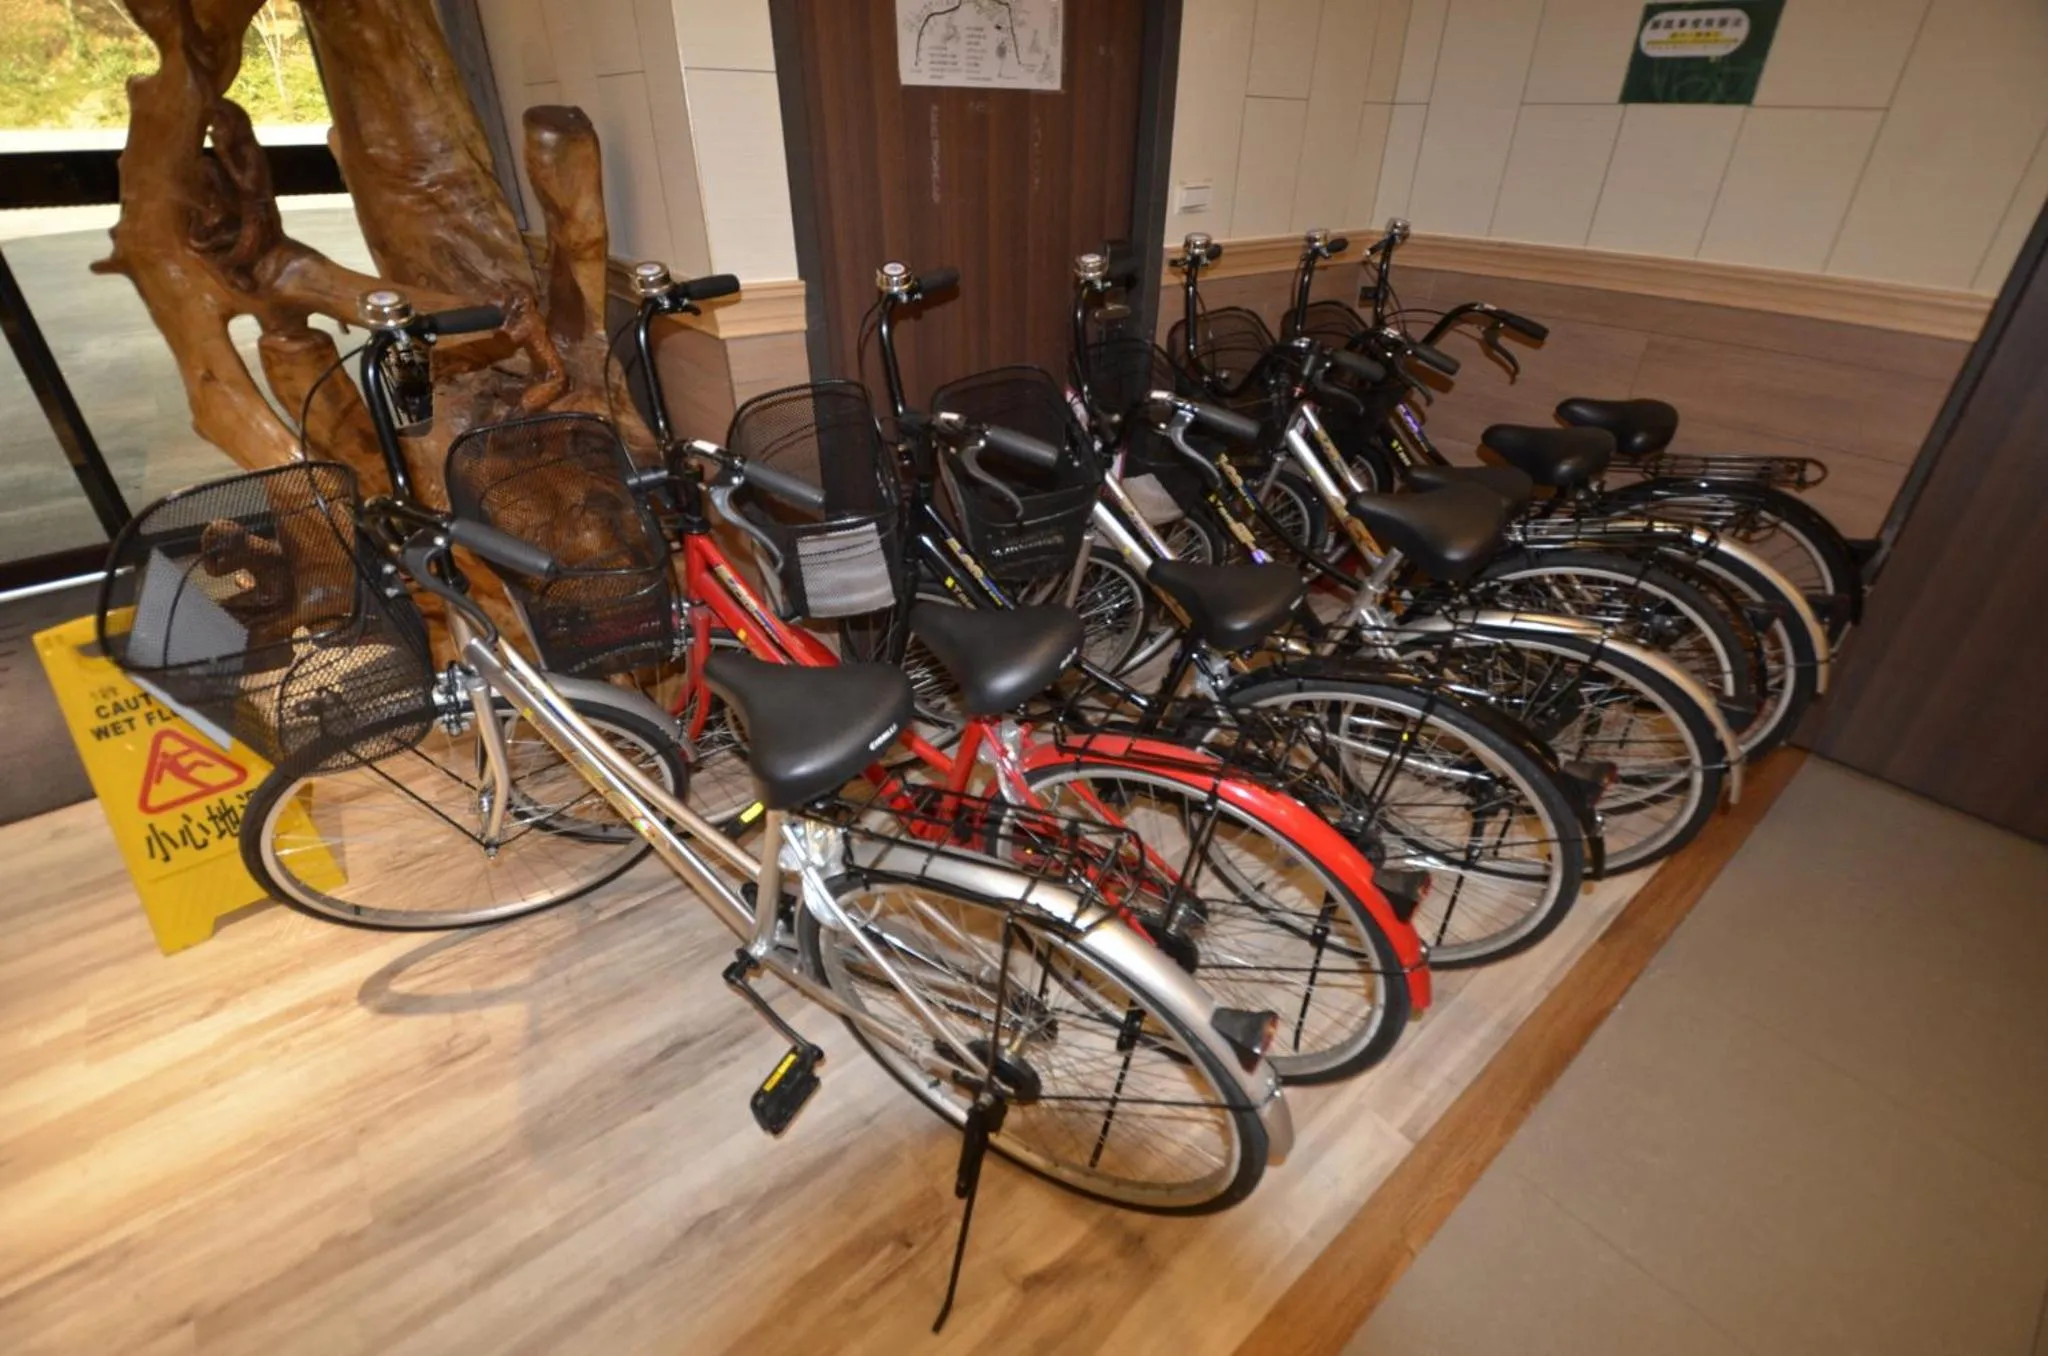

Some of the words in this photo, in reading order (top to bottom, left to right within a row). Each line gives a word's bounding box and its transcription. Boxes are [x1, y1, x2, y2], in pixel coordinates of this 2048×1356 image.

[95, 692, 152, 719] CAUT
[89, 717, 136, 741] WET
[145, 789, 255, 863] 小心地
